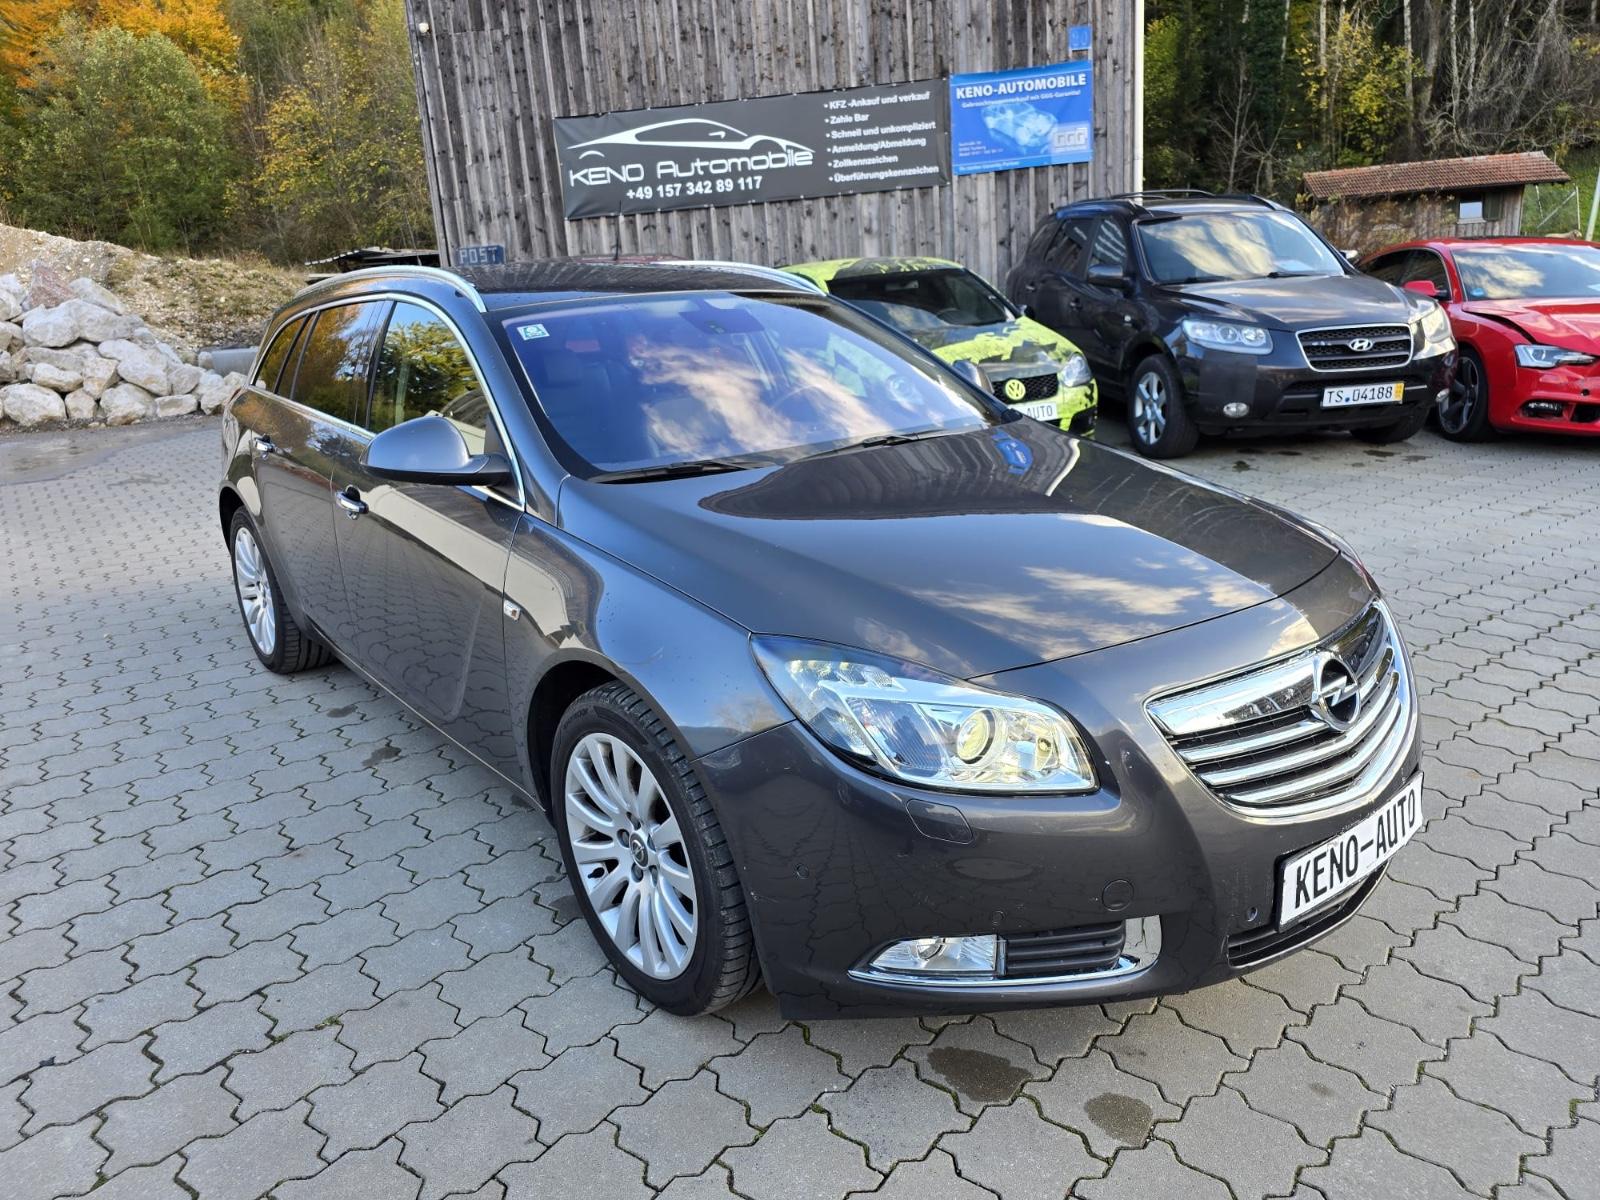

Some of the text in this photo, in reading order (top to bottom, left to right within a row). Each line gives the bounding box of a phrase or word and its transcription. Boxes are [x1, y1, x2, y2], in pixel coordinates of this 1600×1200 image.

[956, 73, 1087, 100] KENO-AUTOMOBILE
[881, 95, 898, 104] und
[899, 91, 931, 102] verkauf
[830, 113, 870, 125] Zahle Bar
[831, 121, 937, 139] Schnell und unkompliziert
[832, 138, 926, 153] Anmeldung/Abmeldung
[569, 148, 813, 188] KENO Automobile
[832, 155, 899, 169] Zollkennzeichen
[833, 166, 939, 182] Überführungskennzeichen
[626, 175, 763, 200] +49 157 342 89 117
[459, 247, 497, 264] POST
[1352, 386, 1393, 402] 04188
[1294, 788, 1416, 909] KENO-AUTO
